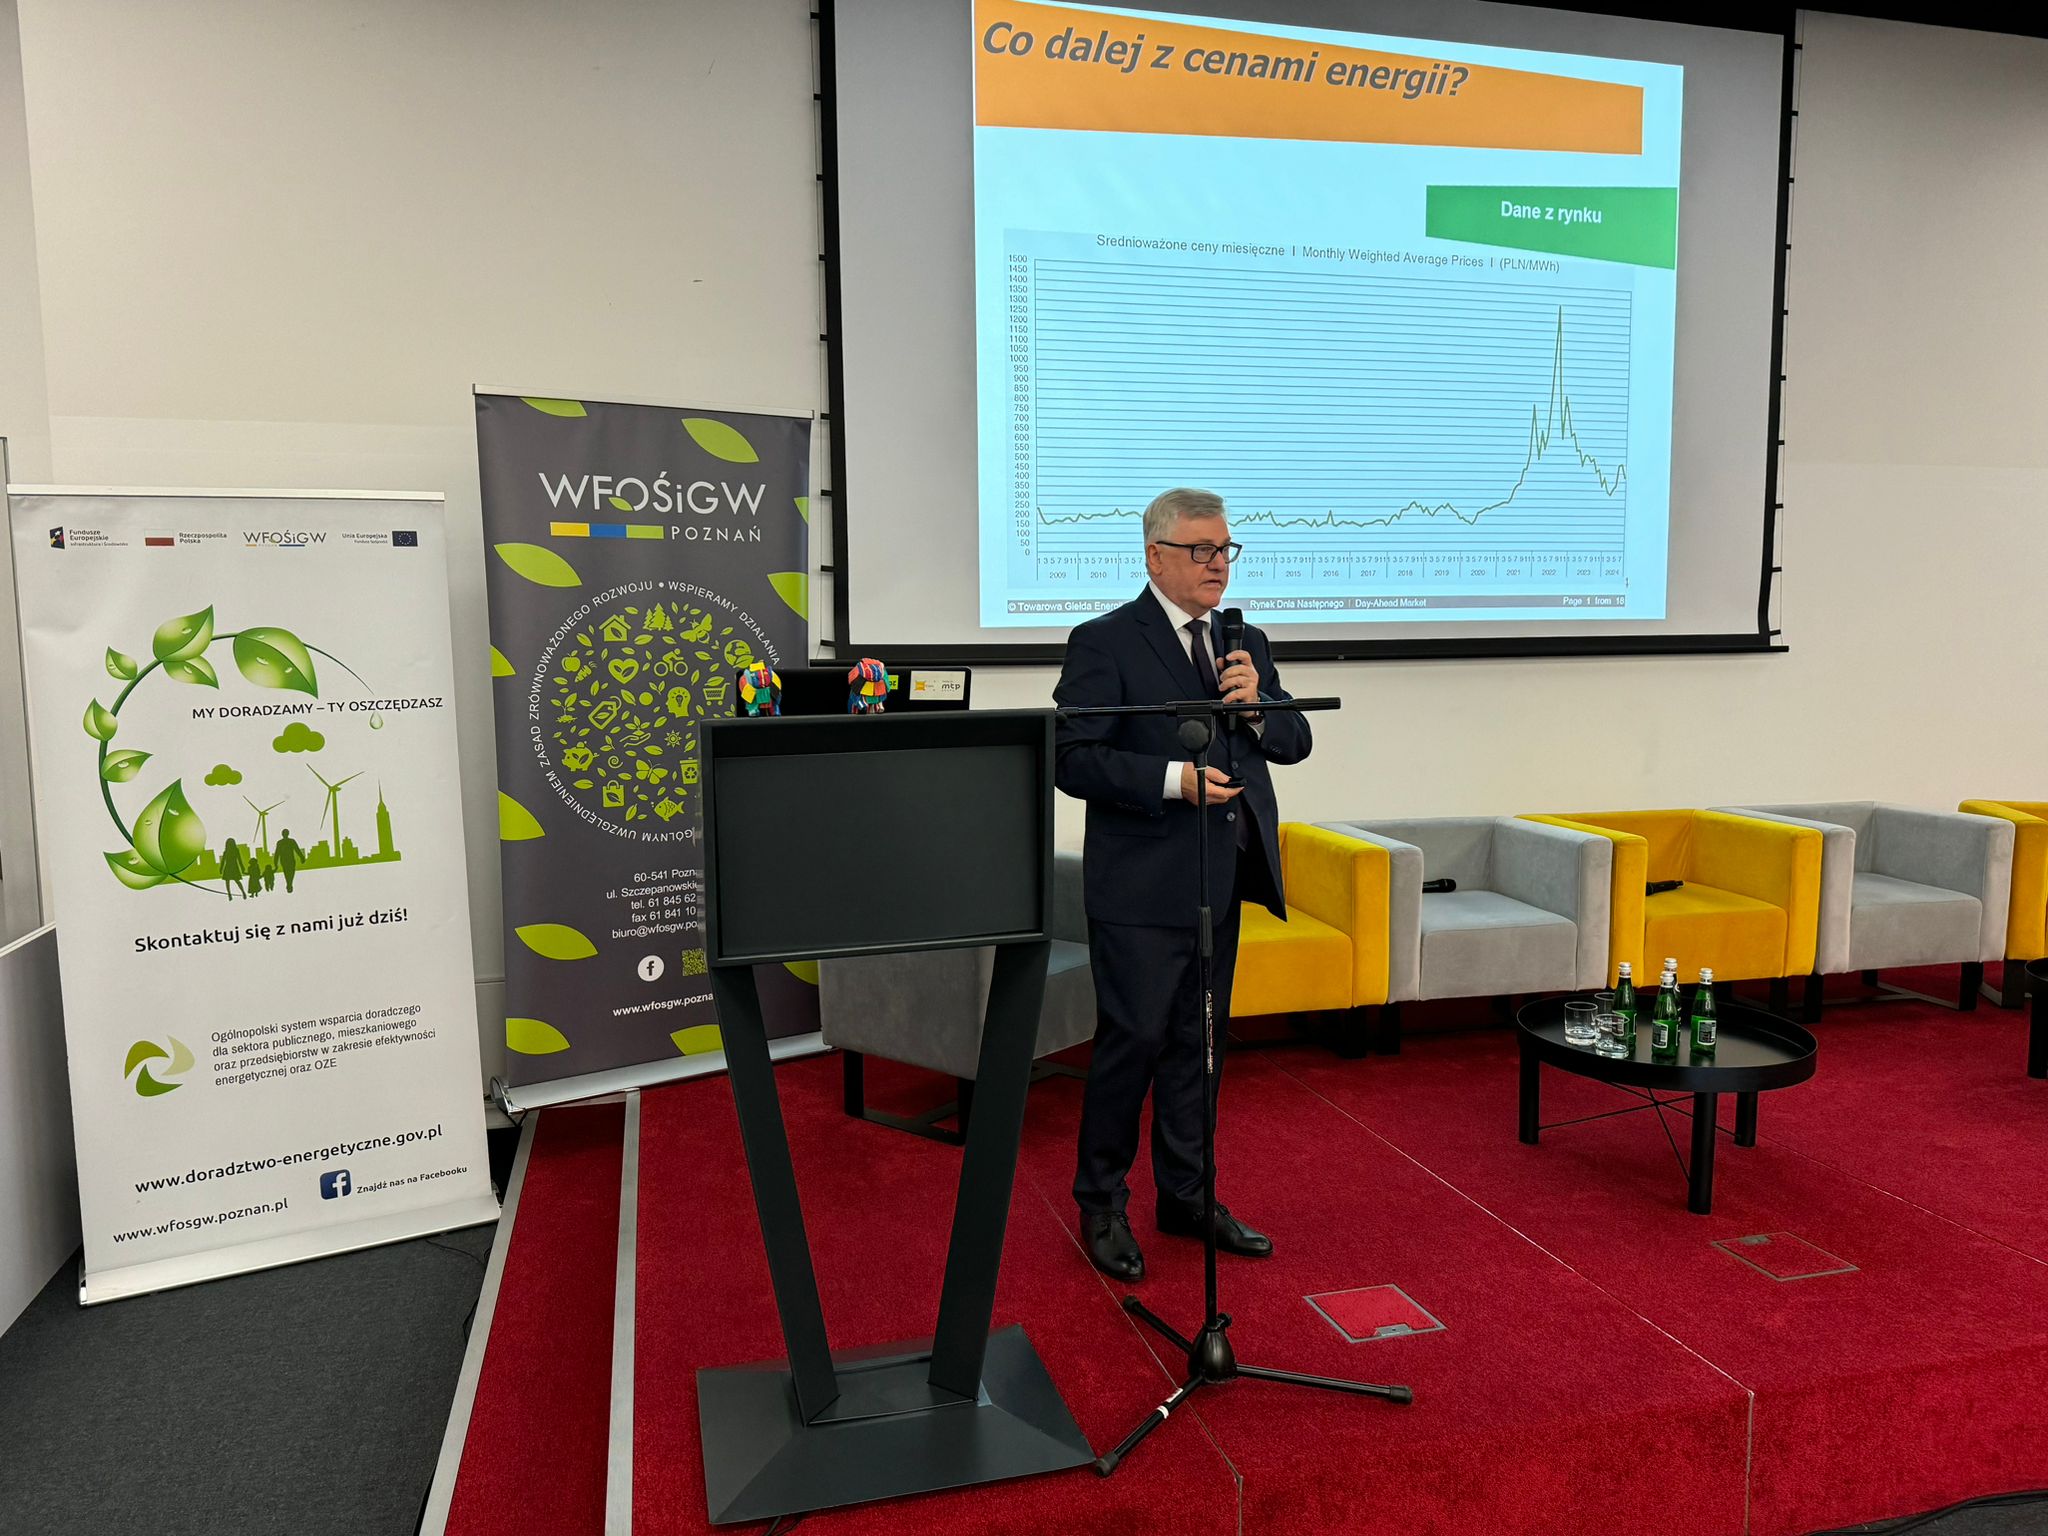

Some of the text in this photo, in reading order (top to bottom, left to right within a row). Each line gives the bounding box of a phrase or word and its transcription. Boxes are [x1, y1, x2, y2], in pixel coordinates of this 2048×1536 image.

[983, 22, 1469, 100] Co dalej z cenami energii?
[1501, 200, 1601, 225] Dane z rynku
[1009, 254, 1028, 262] 1500
[1191, 241, 1218, 255] ceny
[1222, 243, 1285, 257] miesięczne
[1303, 246, 1345, 262] Monthly
[1349, 249, 1400, 263] Weighted
[1403, 253, 1448, 266] Average
[1451, 255, 1484, 267] Prices
[1499, 258, 1560, 274] (PLN/MWh)
[1009, 275, 1028, 283] 1400
[1009, 285, 1028, 293] 1350
[1009, 295, 1028, 303] 1300
[1010, 305, 1028, 313] 1250
[1010, 315, 1028, 323] 1200
[1010, 325, 1028, 333] 1150
[1010, 335, 1028, 343] 1100
[1010, 354, 1028, 362] 1000
[1014, 374, 1028, 382] 900
[1014, 384, 1029, 392] 850
[1014, 394, 1029, 402] 800
[1014, 404, 1029, 412] 750
[1014, 414, 1029, 422] 700
[1015, 443, 1029, 451] 550
[1015, 481, 1029, 489] 350
[538, 471, 766, 516] WFOŚiGW
[1015, 491, 1029, 499] 300
[1015, 510, 1030, 518] 200
[179, 532, 227, 540] Rzeczpospolita
[243, 530, 327, 544] WFOŚiGW
[672, 525, 761, 542] POZNAŃ
[1016, 529, 1030, 537] 100
[1017, 602, 1063, 611] Towarowa
[1250, 600, 1275, 610] Rynek
[1277, 600, 1295, 608] Dnia
[1355, 599, 1398, 608] Day-Ahead
[1400, 599, 1426, 607] Market
[1563, 597, 1582, 606] Page
[1595, 597, 1612, 605] from
[668, 581, 780, 665] WSPIERAMY DZIAŁANIA
[193, 707, 215, 719] MY
[219, 703, 313, 718] DORADZAMY
[327, 702, 345, 713] TY
[349, 697, 443, 712] OSZCZĘDZASZ
[528, 581, 693, 842] GÓLNYM UWZGLĘDNIENIEM ZASAD ZRÓWNOWAŻONEGO ROZWOJU
[634, 870, 668, 883] 60-541
[606, 889, 618, 899] ul.
[631, 893, 696, 909] tel. 61 845 62
[631, 906, 696, 922] fax 61 841 10
[135, 908, 408, 952] Skontaktuj się z nami już dziś!
[612, 921, 698, 939] biuro@wfosgw.po
[211, 1004, 421, 1043] Ogólnopolski system wsparcia doradczego
[213, 1019, 417, 1057] dla sektora publicznego, mieszkaniowego
[214, 1028, 436, 1071] oraz przedsiębiorstw w zakresie efektywności
[215, 1058, 337, 1086] energetycznej oraz OZE
[135, 1124, 443, 1193] www.doradztwo-energetyczne.gov.pl
[356, 1166, 468, 1194] Znajdź nas na Facebooku
[113, 1198, 288, 1243] www.wfosgw.poznan.pl
